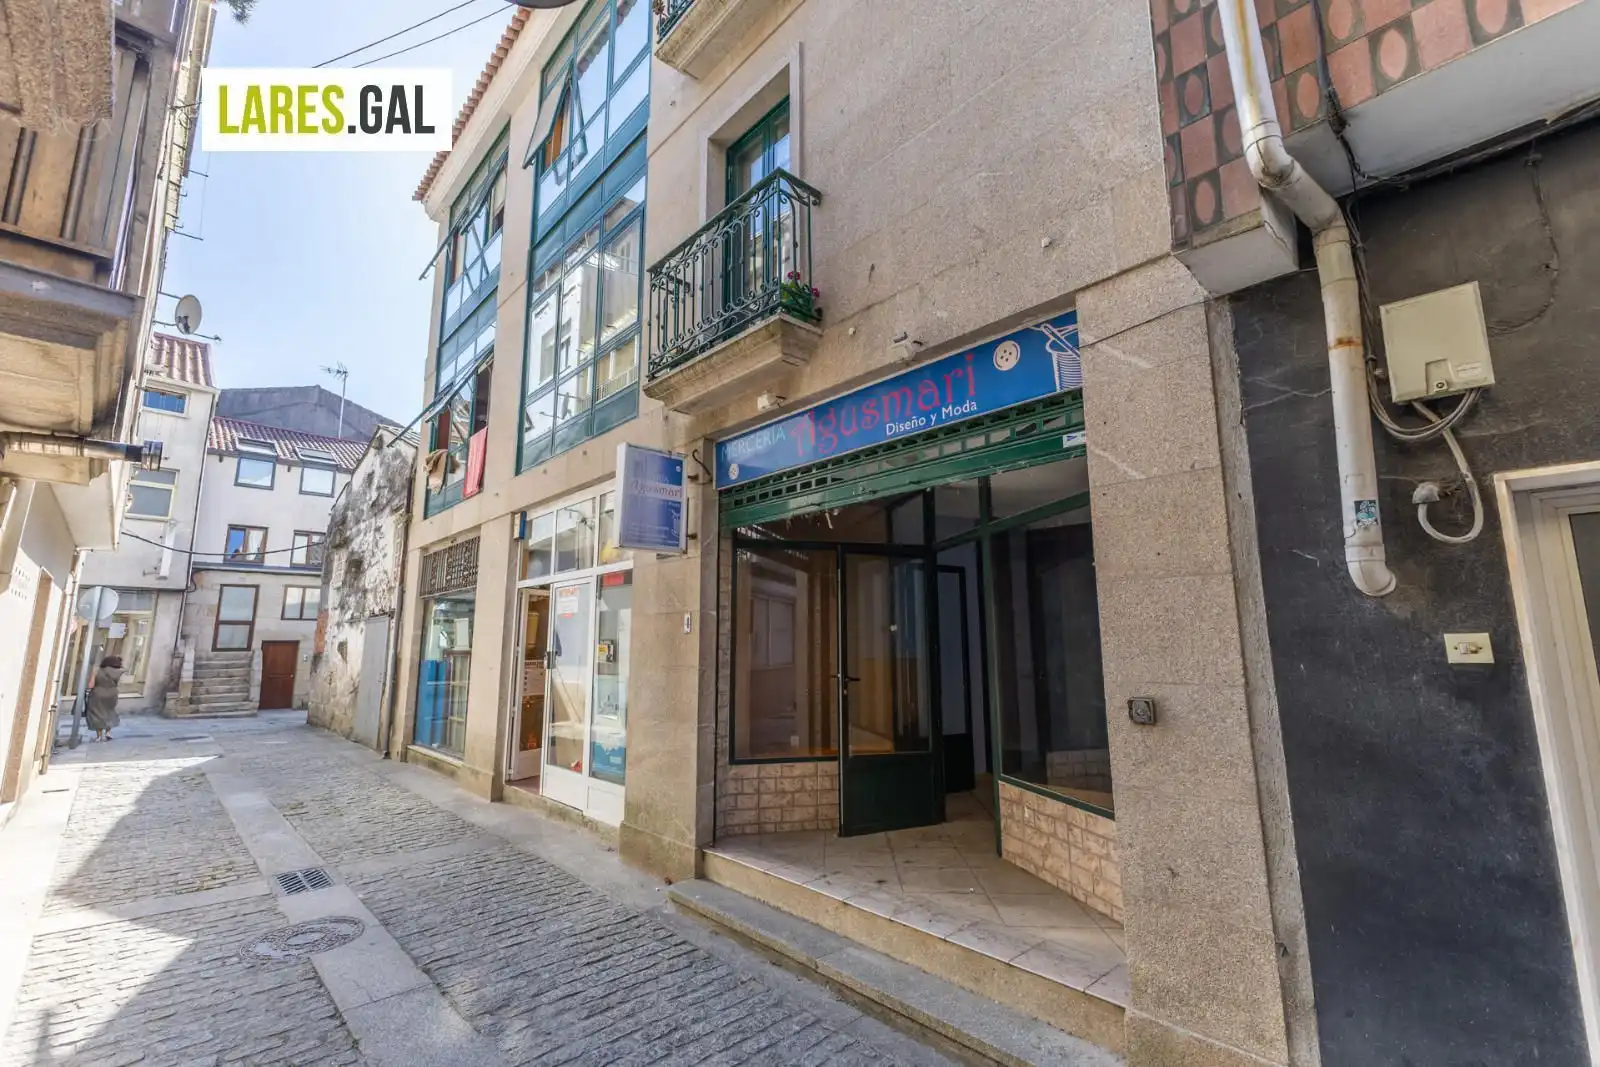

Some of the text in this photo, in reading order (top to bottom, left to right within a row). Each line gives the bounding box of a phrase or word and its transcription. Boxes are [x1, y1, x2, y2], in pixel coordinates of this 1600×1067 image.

[886, 399, 977, 436] Diseño y Moda
